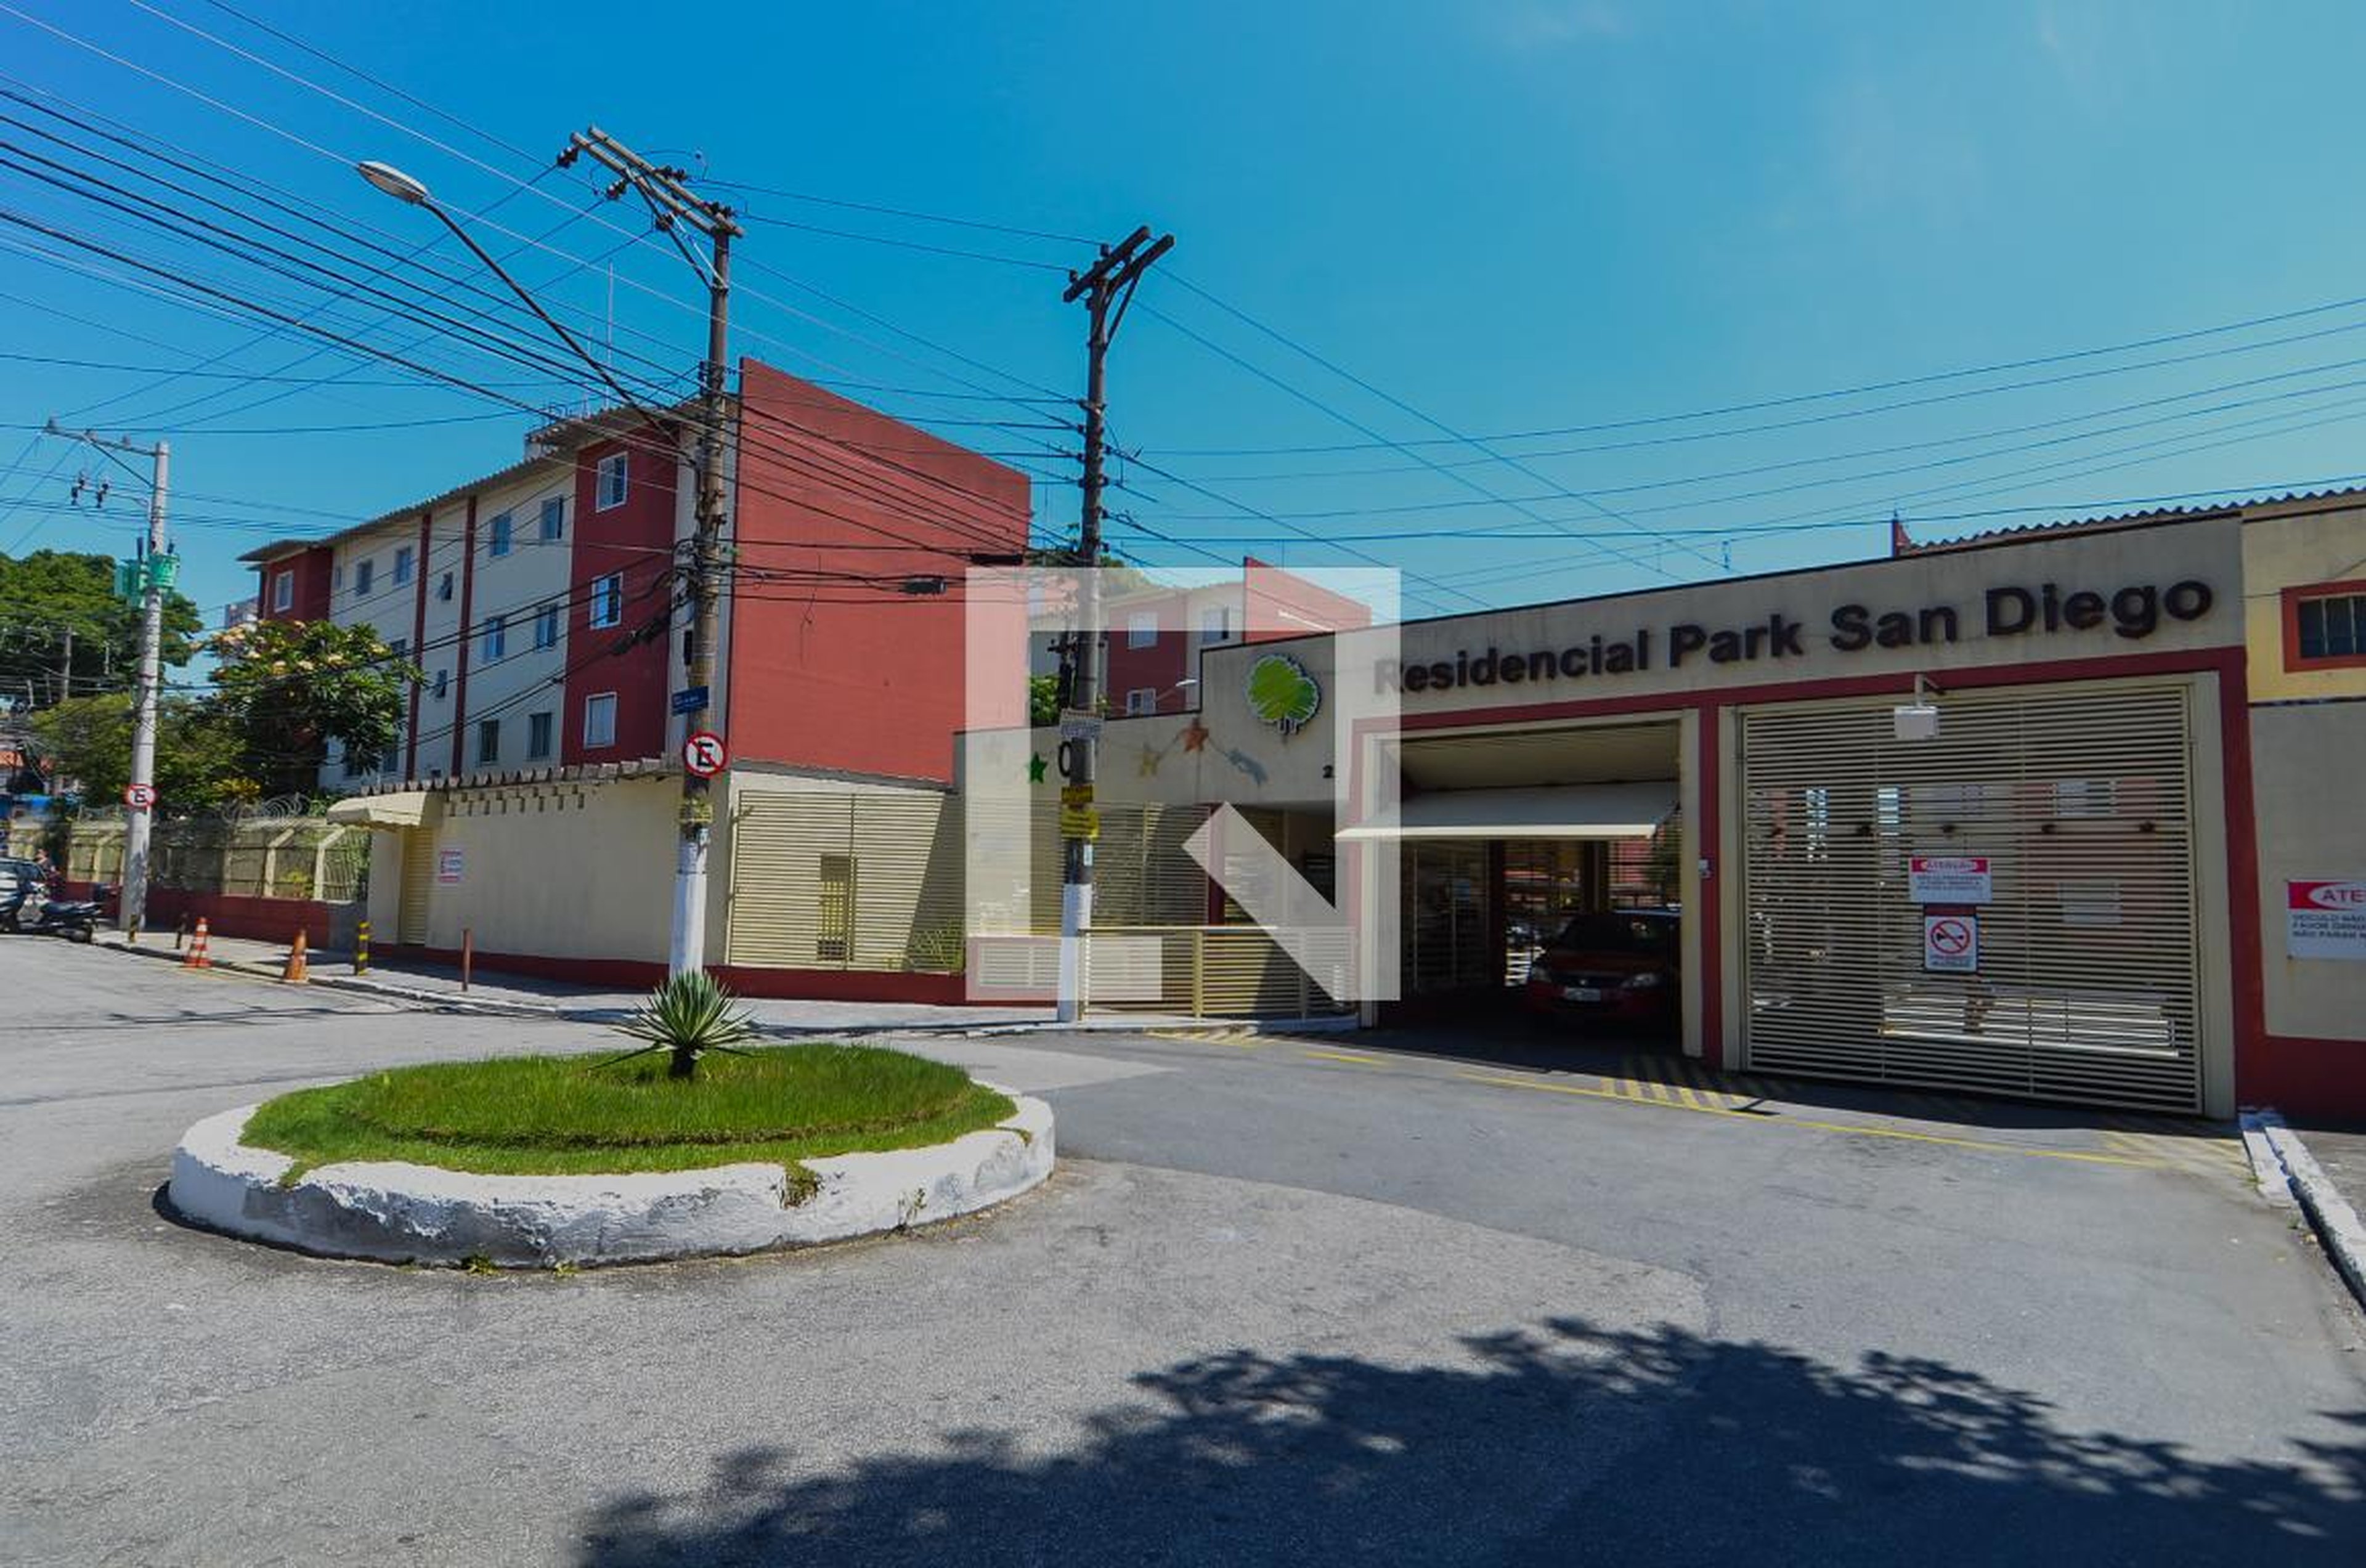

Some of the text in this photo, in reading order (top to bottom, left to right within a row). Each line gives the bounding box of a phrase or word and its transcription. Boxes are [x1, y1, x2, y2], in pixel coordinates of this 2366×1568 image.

[1373, 580, 2214, 695] Residencial Park San Diego
